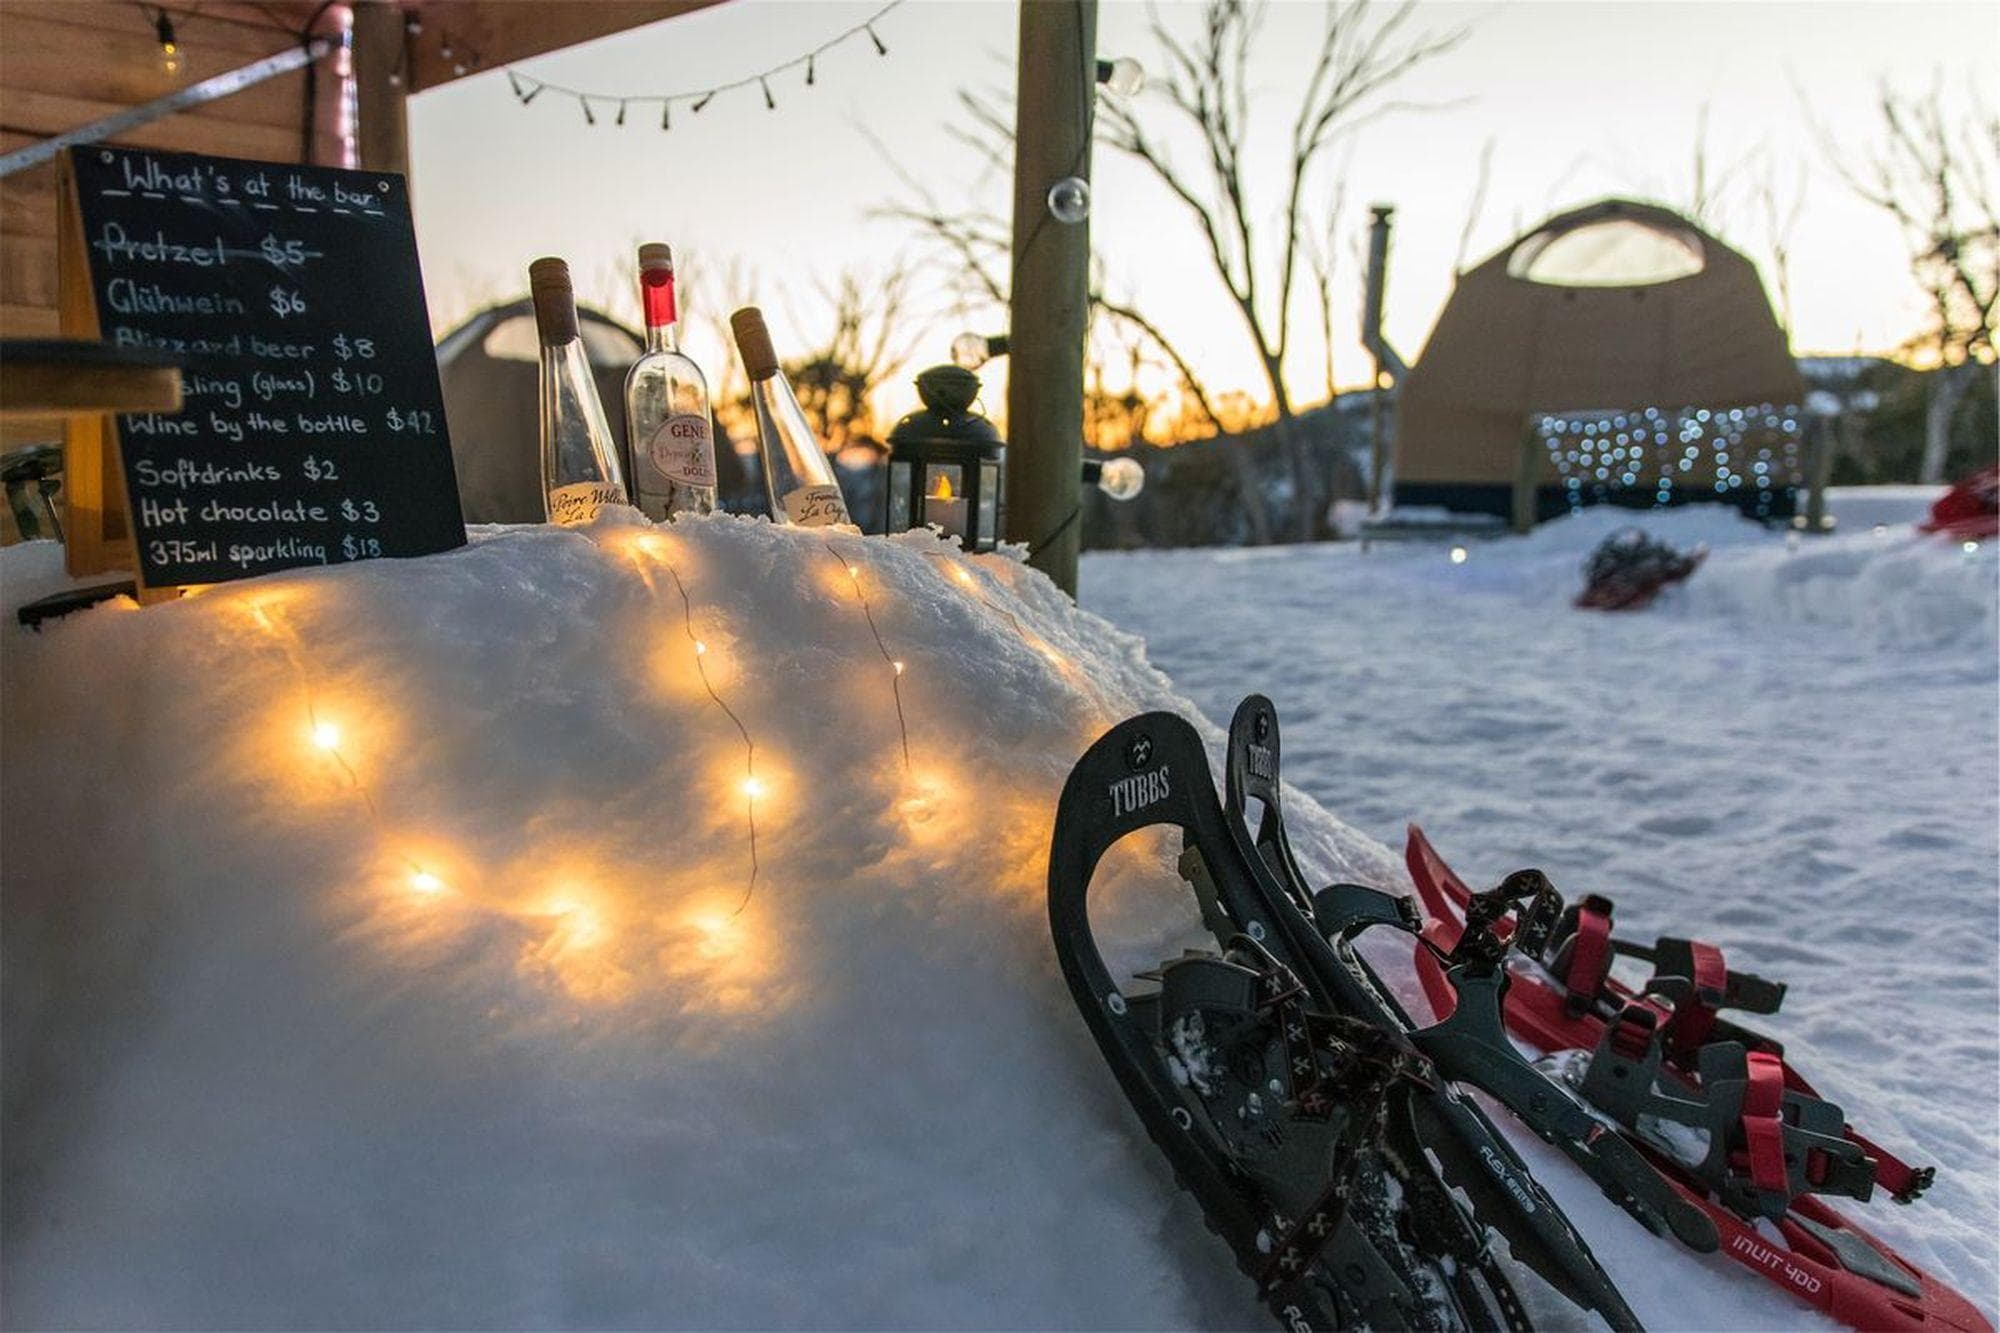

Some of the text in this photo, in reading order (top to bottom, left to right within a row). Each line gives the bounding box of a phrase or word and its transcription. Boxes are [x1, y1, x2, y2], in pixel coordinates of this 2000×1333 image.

[123, 157, 230, 193] What's
[246, 171, 269, 197] at
[286, 173, 326, 201] the
[103, 223, 306, 267] Pretzel $5
[107, 278, 306, 319] Glühwein $6
[115, 327, 375, 361] Blizzard beer $8
[181, 367, 384, 408] sling (glass) $10
[127, 412, 199, 435] Wine
[210, 412, 244, 441] by
[249, 414, 289, 434] the
[299, 413, 368, 434] bottle
[138, 457, 339, 490] Softdrinks $2
[143, 499, 381, 528] Hot chocolate $3
[149, 535, 382, 570] 375ml sparkling $18
[1109, 765, 1170, 817] TUBBS
[1732, 1234, 1823, 1295] INUIT 400
